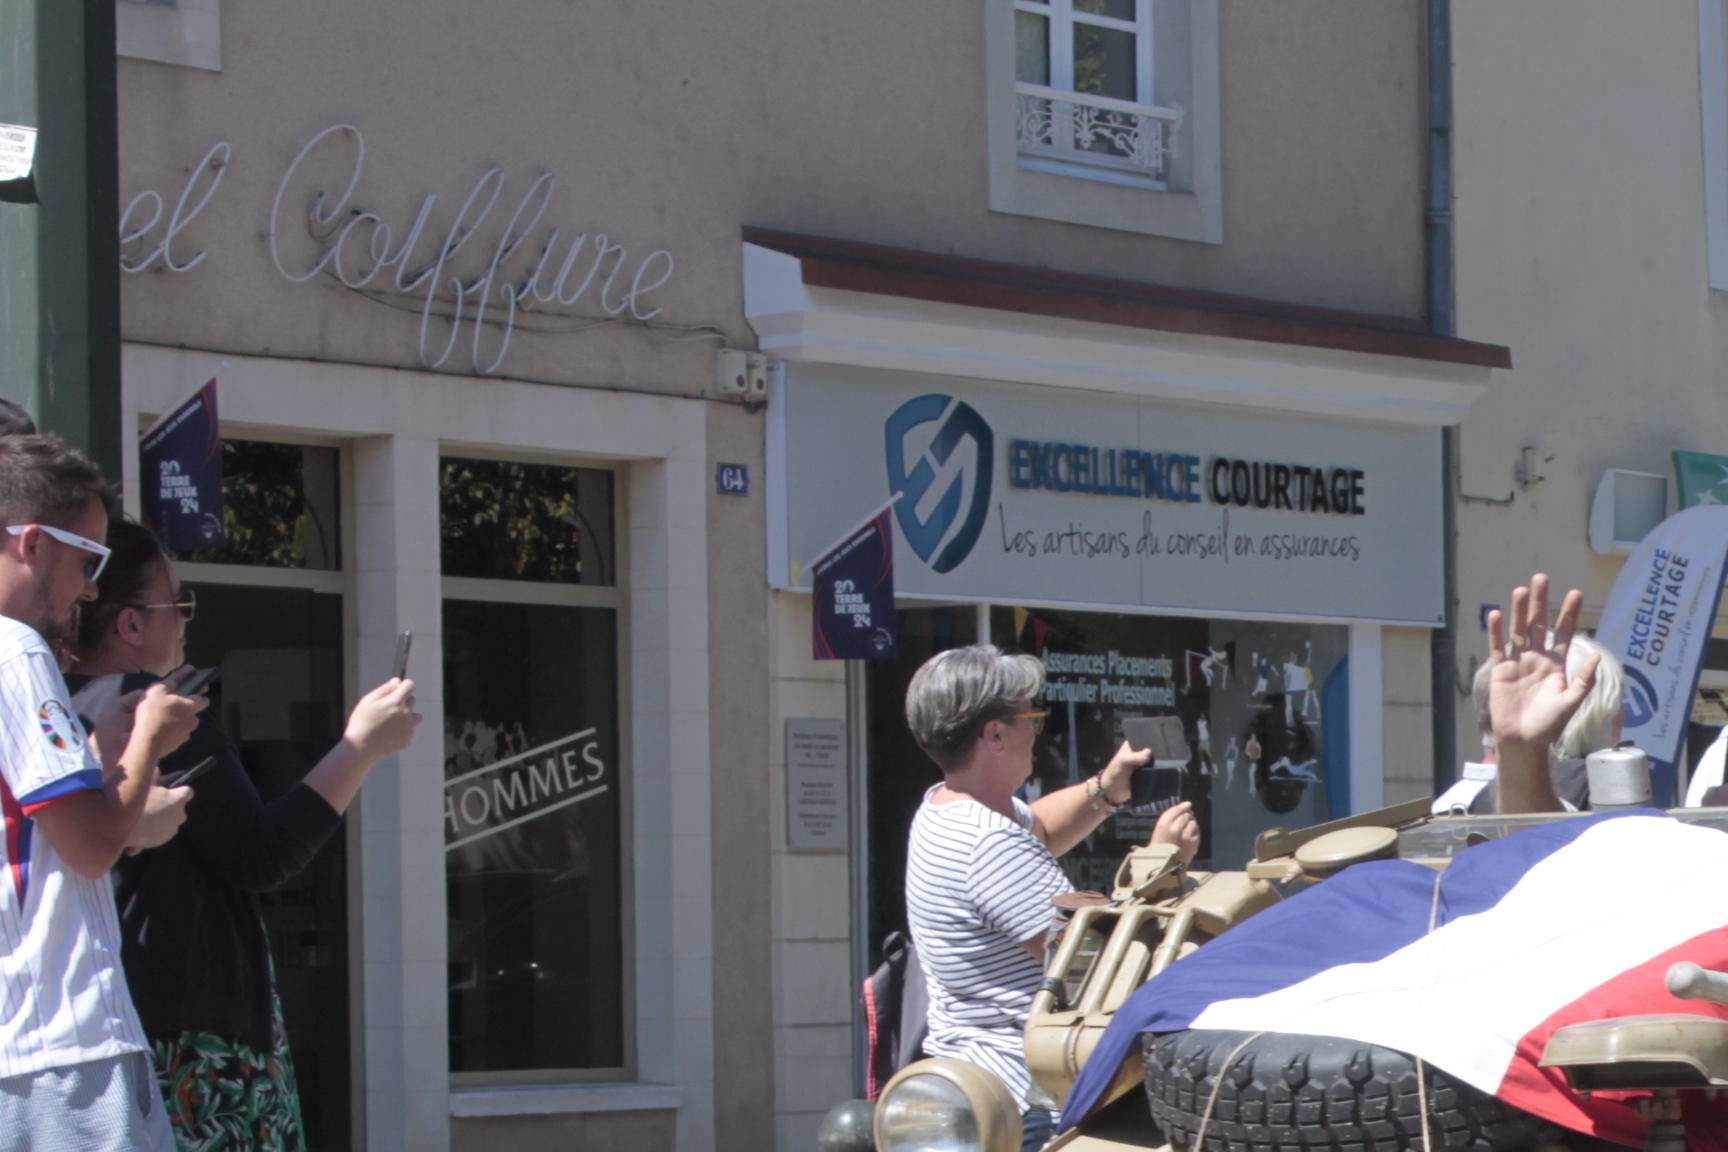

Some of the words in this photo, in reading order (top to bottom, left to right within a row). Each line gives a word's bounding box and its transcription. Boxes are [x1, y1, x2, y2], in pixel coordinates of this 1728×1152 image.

[270, 124, 674, 374] Coiffure
[159, 475, 191, 487] TERRE
[160, 487, 172, 499] DE
[174, 486, 198, 498] JEUX
[722, 467, 744, 490] 64
[1011, 439, 1201, 503] EXCELLENCE
[1210, 457, 1365, 515] COURTAGE
[999, 502, 1036, 557] Les
[1044, 521, 1129, 559] artisans
[1137, 510, 1159, 551] du
[1166, 509, 1229, 564] conseil
[1234, 533, 1255, 552] en
[1260, 532, 1360, 561] assurances
[834, 593, 864, 603] TERRE
[834, 604, 845, 614] DE
[846, 603, 870, 614] JEUX
[1627, 548, 1670, 660] EXCELLENCE
[1646, 554, 1689, 666] COURTAGE
[1042, 647, 1106, 674] Assurances
[1108, 650, 1172, 678] Placements
[1101, 679, 1175, 706] Professionnel
[1664, 679, 1680, 721] artisans
